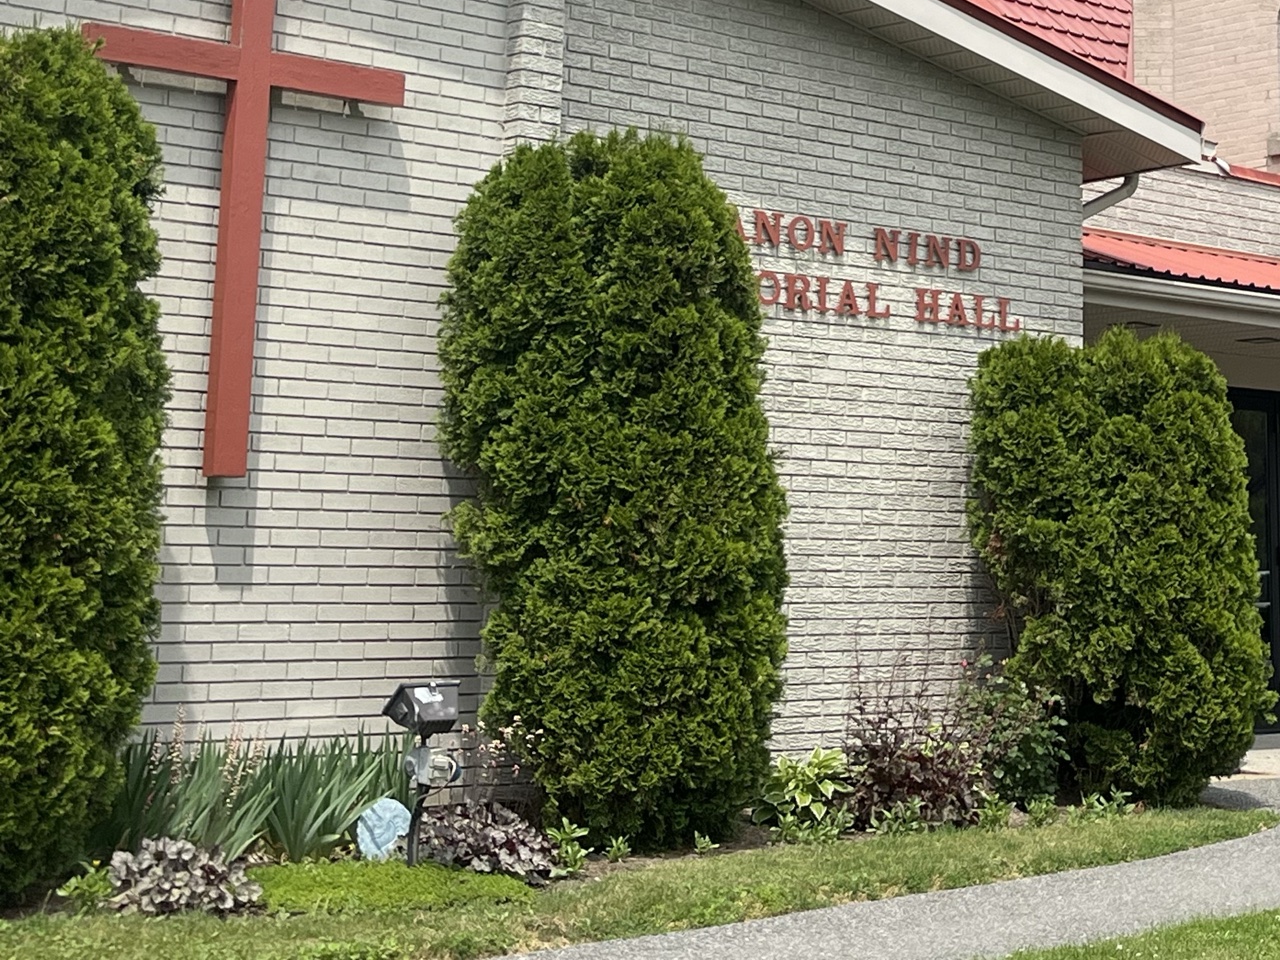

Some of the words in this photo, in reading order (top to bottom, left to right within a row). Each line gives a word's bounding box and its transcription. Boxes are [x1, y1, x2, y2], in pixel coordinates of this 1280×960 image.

[873, 227, 982, 272] NIND
[757, 270, 891, 319] ORIAL
[914, 288, 1020, 332] HALL
